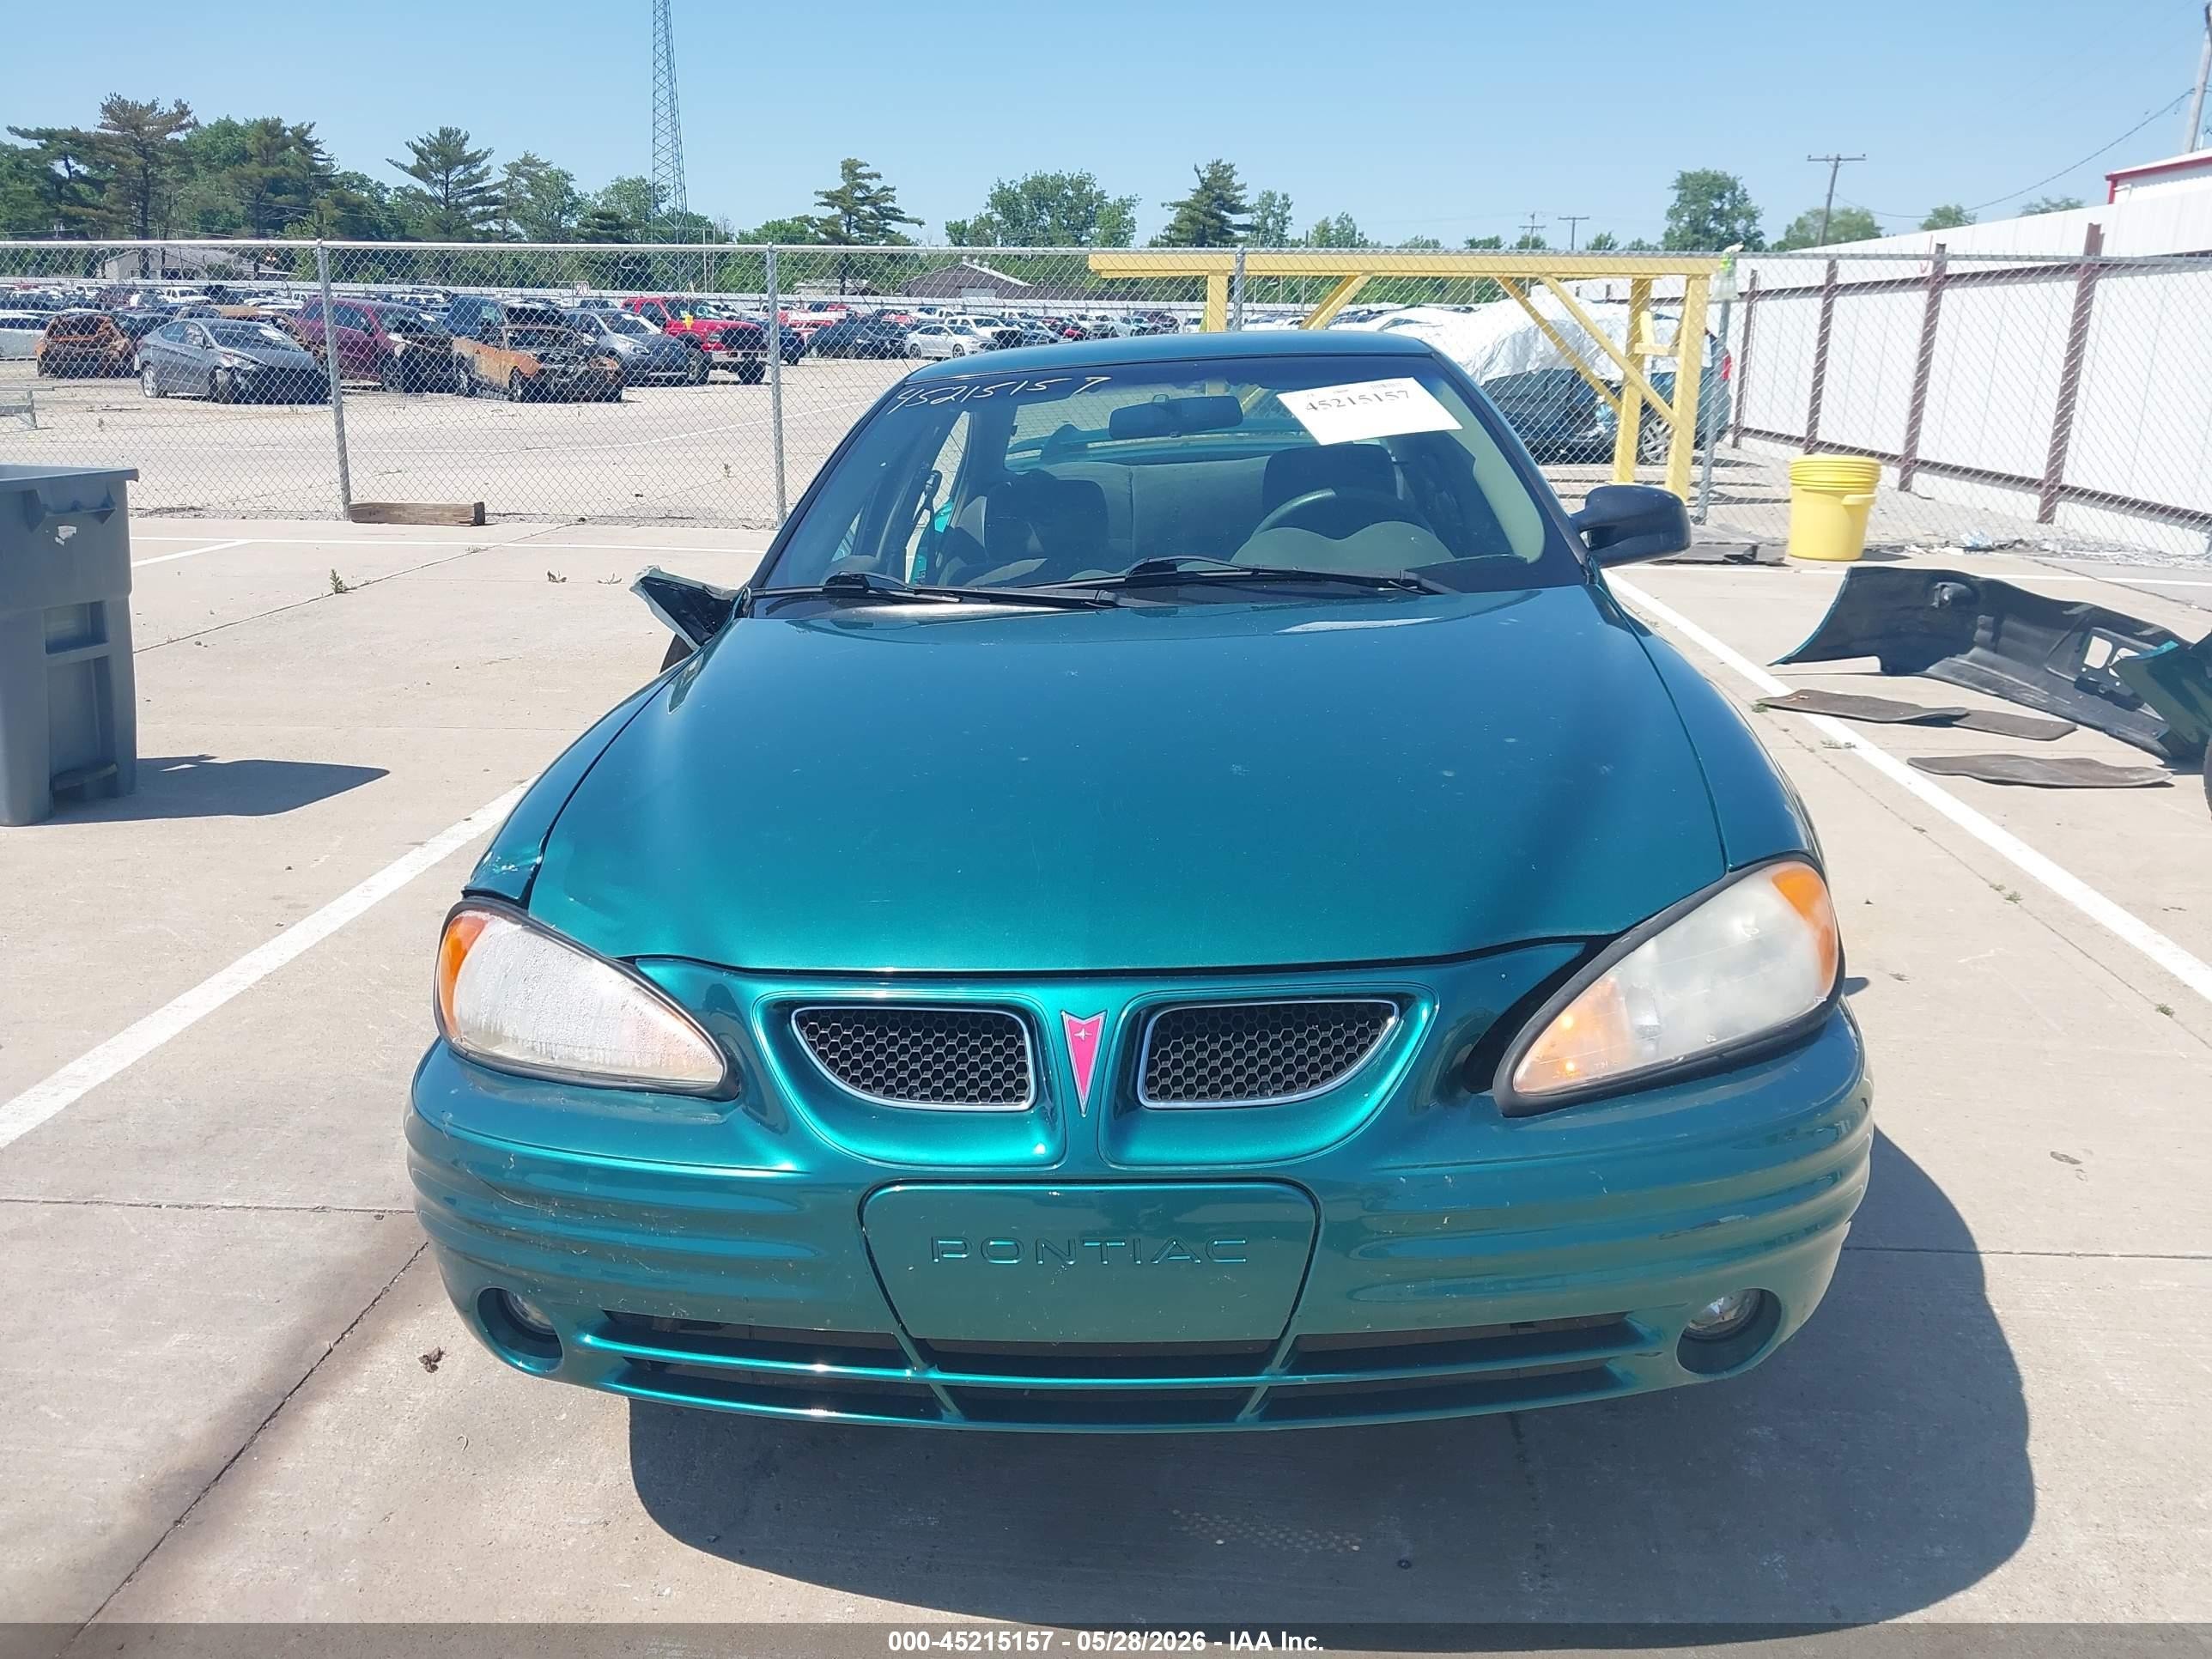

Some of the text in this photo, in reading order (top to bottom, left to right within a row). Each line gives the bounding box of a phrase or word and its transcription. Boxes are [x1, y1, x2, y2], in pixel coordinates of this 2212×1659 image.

[575, 282, 590, 296] 20
[1305, 390, 1409, 411] 45215157
[930, 1235, 1248, 1266] PONTIAC
